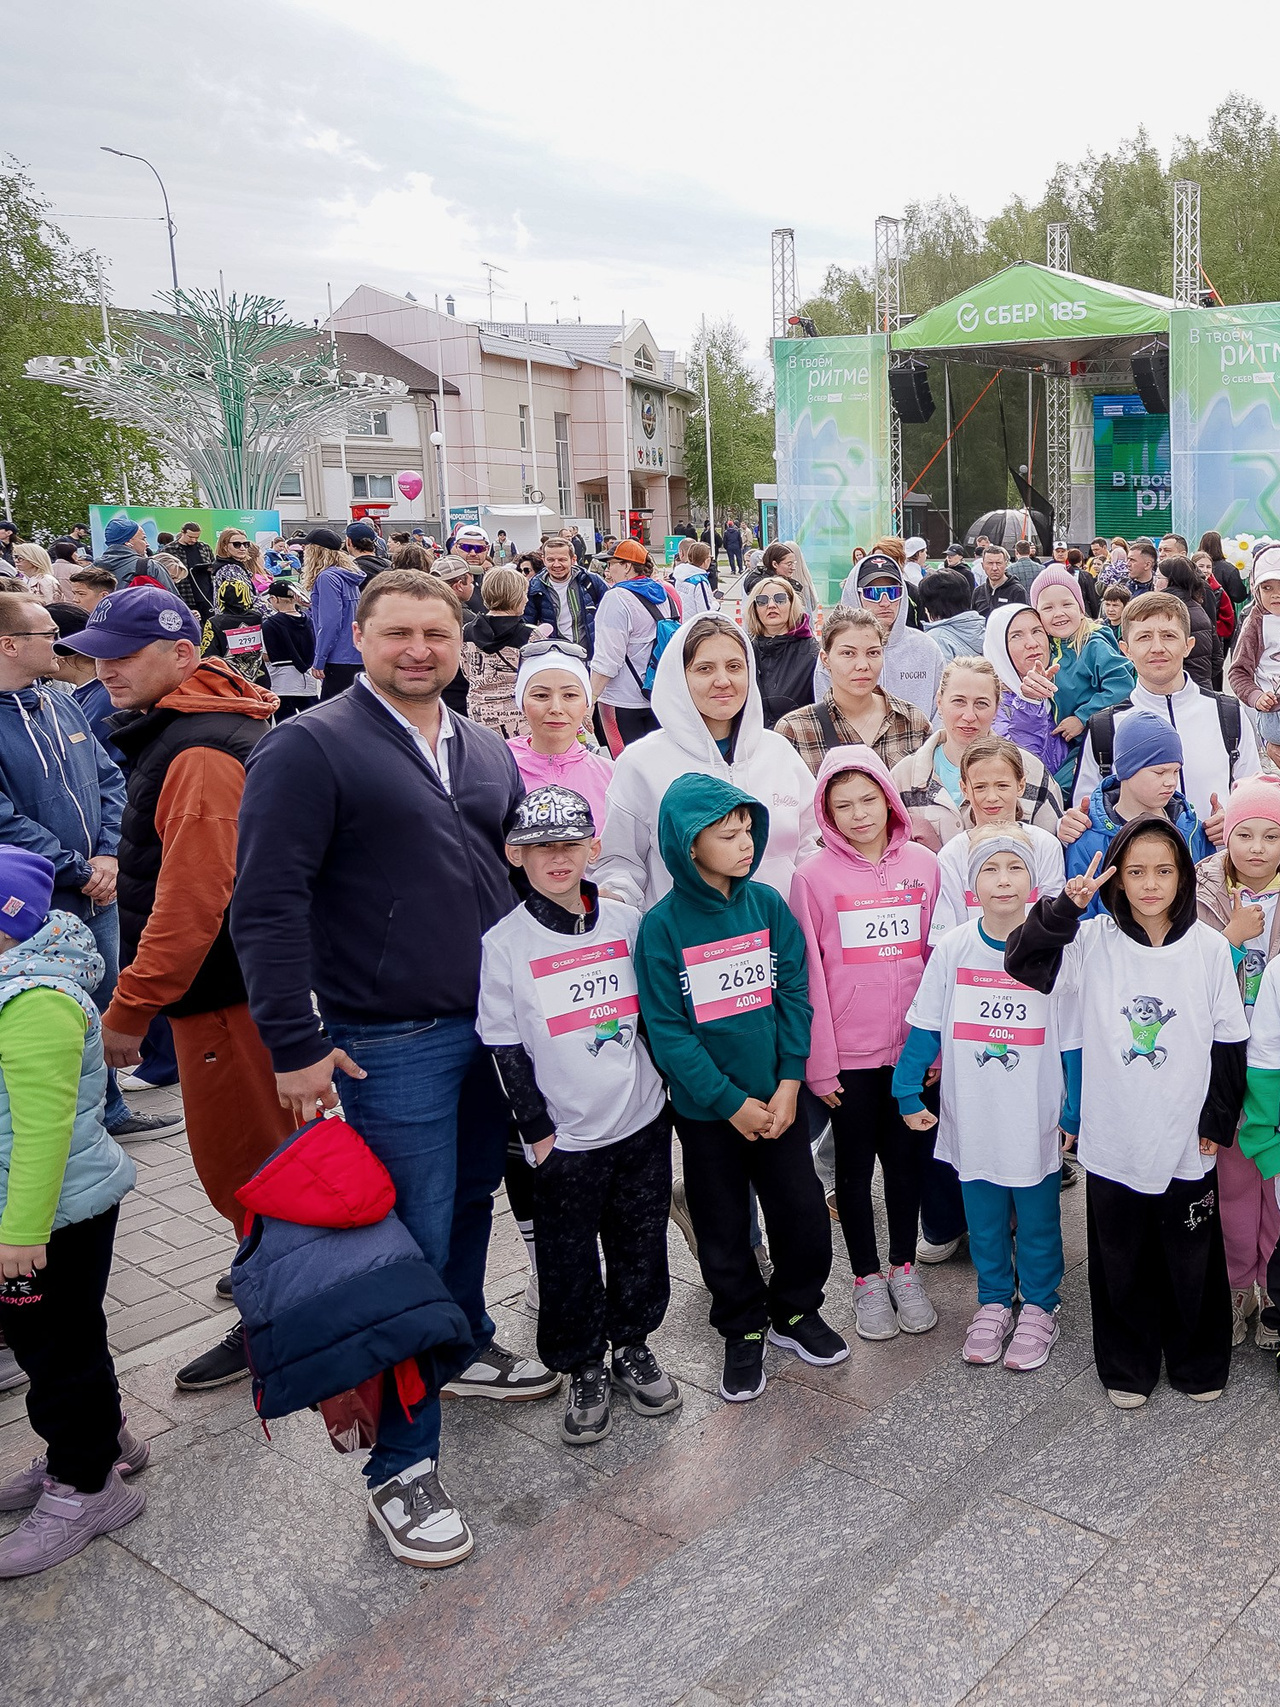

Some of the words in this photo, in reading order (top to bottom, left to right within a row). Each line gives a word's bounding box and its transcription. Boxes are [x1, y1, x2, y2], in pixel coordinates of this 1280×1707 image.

[984, 303, 1038, 325] СБЕР
[1049, 301, 1088, 321] 185
[1190, 328, 1200, 344] В
[1206, 327, 1253, 344] твоём
[789, 356, 797, 368] В
[800, 355, 833, 368] твоём
[808, 367, 869, 392] ритме
[1112, 471, 1126, 487] В
[1130, 470, 1172, 487] твоё
[865, 918, 910, 940] 2613
[878, 946, 903, 957] 400м
[718, 964, 765, 991] 2628
[569, 974, 619, 1003] 2979
[736, 994, 762, 1008] 400м
[589, 1005, 618, 1019] 400м
[980, 1001, 1027, 1021] 2693
[988, 1028, 1015, 1040] 400м
